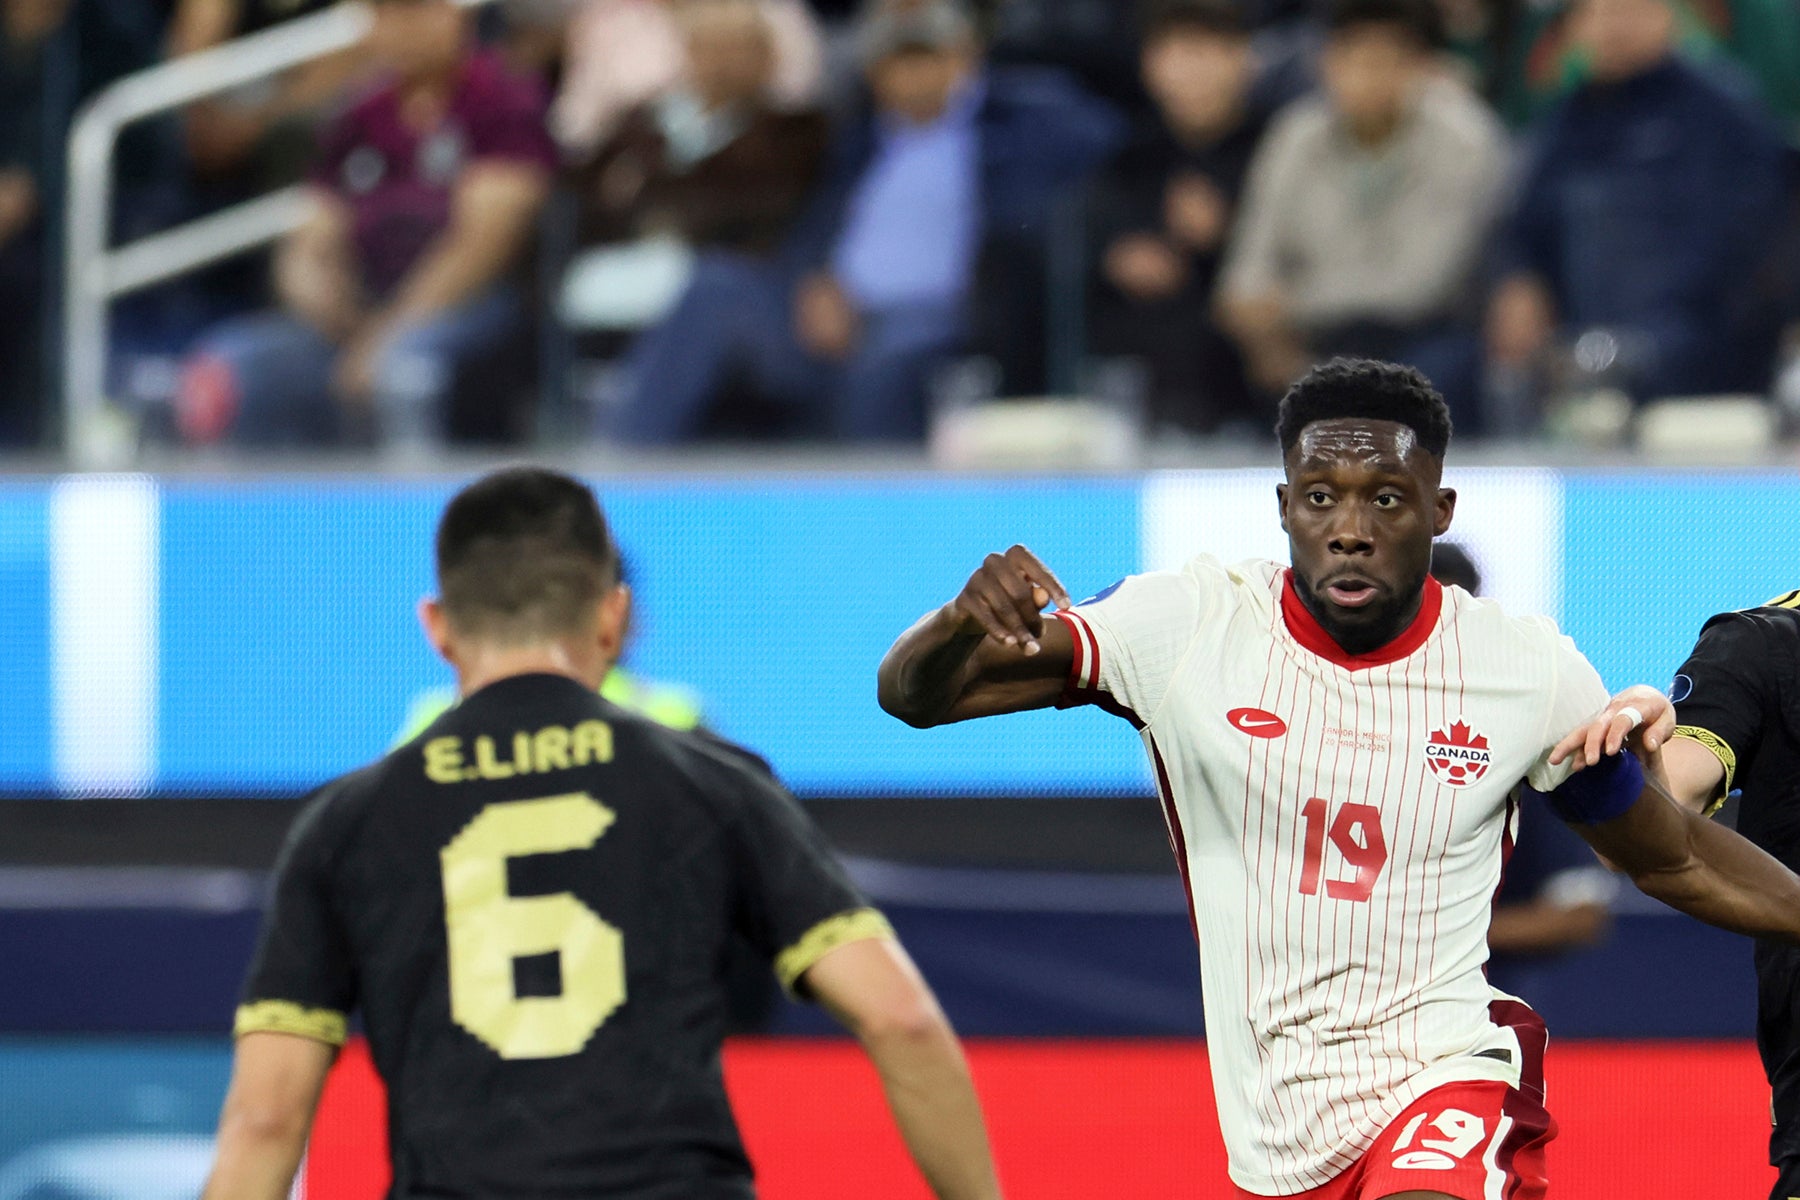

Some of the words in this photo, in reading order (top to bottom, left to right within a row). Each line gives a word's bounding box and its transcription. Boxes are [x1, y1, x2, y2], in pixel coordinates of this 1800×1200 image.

[423, 720, 614, 784] E.LIRA
[1339, 740, 1365, 750] MARCH
[1425, 745, 1490, 763] CANADA
[1298, 797, 1388, 903] 19
[439, 791, 628, 1061] 6
[1391, 1108, 1486, 1159] 19
